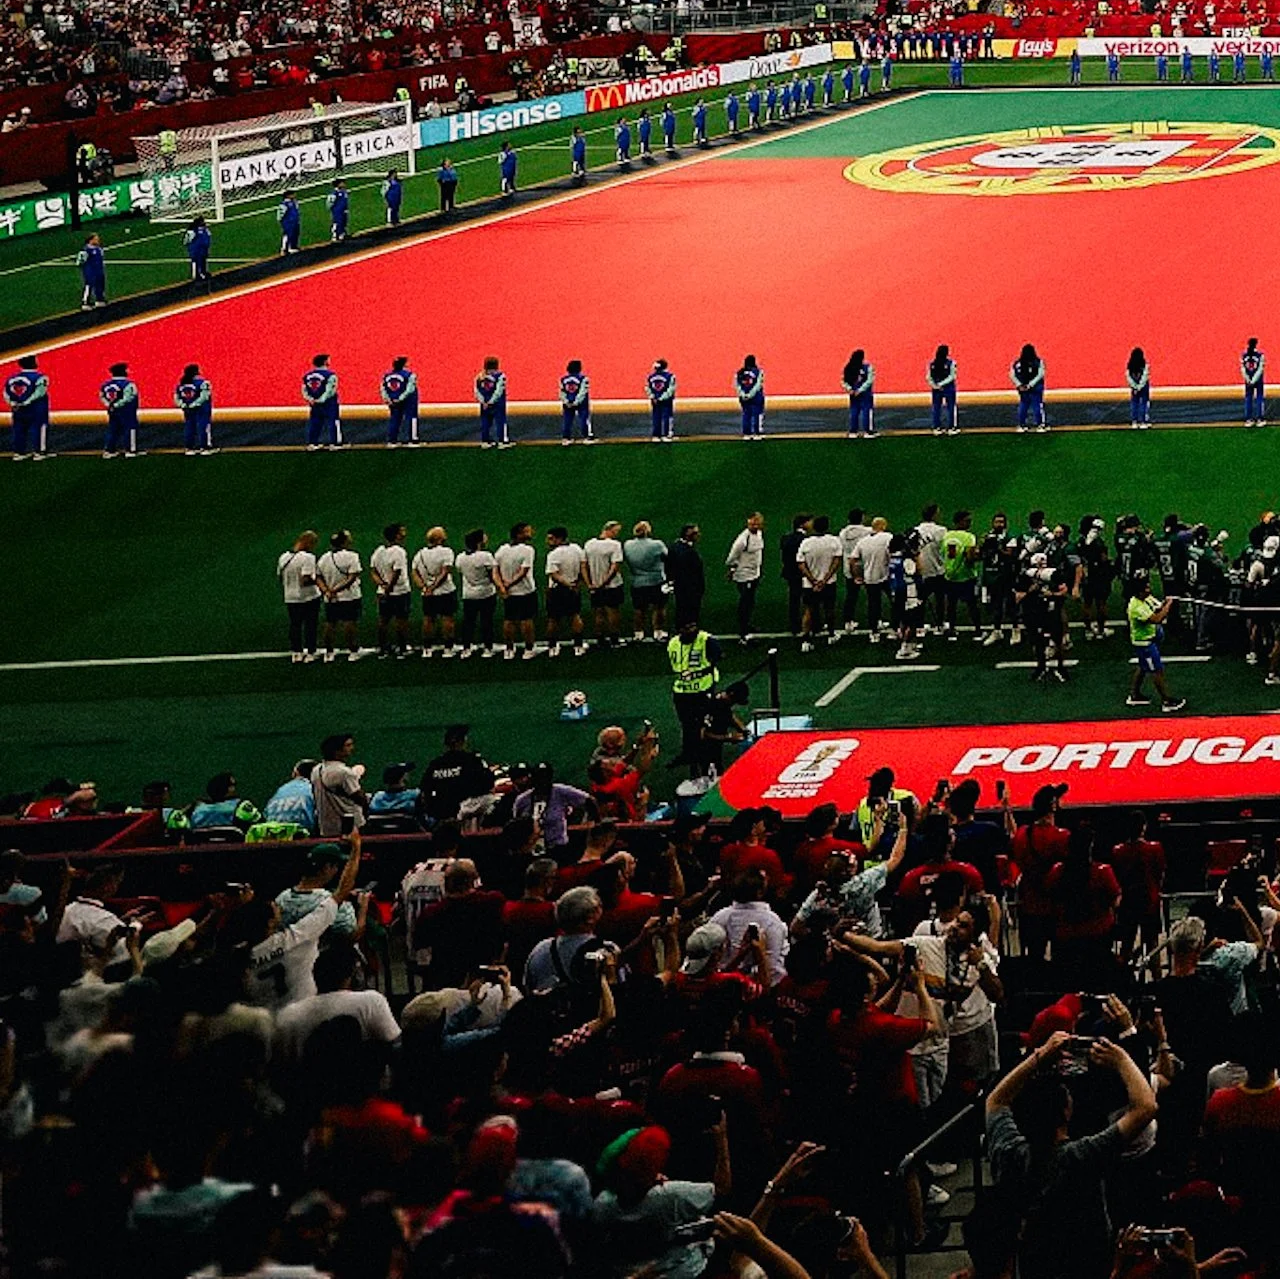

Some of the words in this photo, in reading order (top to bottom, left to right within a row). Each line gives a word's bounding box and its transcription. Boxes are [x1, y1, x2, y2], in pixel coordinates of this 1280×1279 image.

[1222, 27, 1254, 38] FIFA
[1017, 38, 1055, 58] Lay's
[1105, 37, 1180, 55] verizon
[418, 74, 449, 92] FIFA
[625, 71, 720, 105] McDonald's
[449, 101, 563, 143] Hisense
[221, 156, 278, 185] BANK
[284, 150, 309, 171] OF
